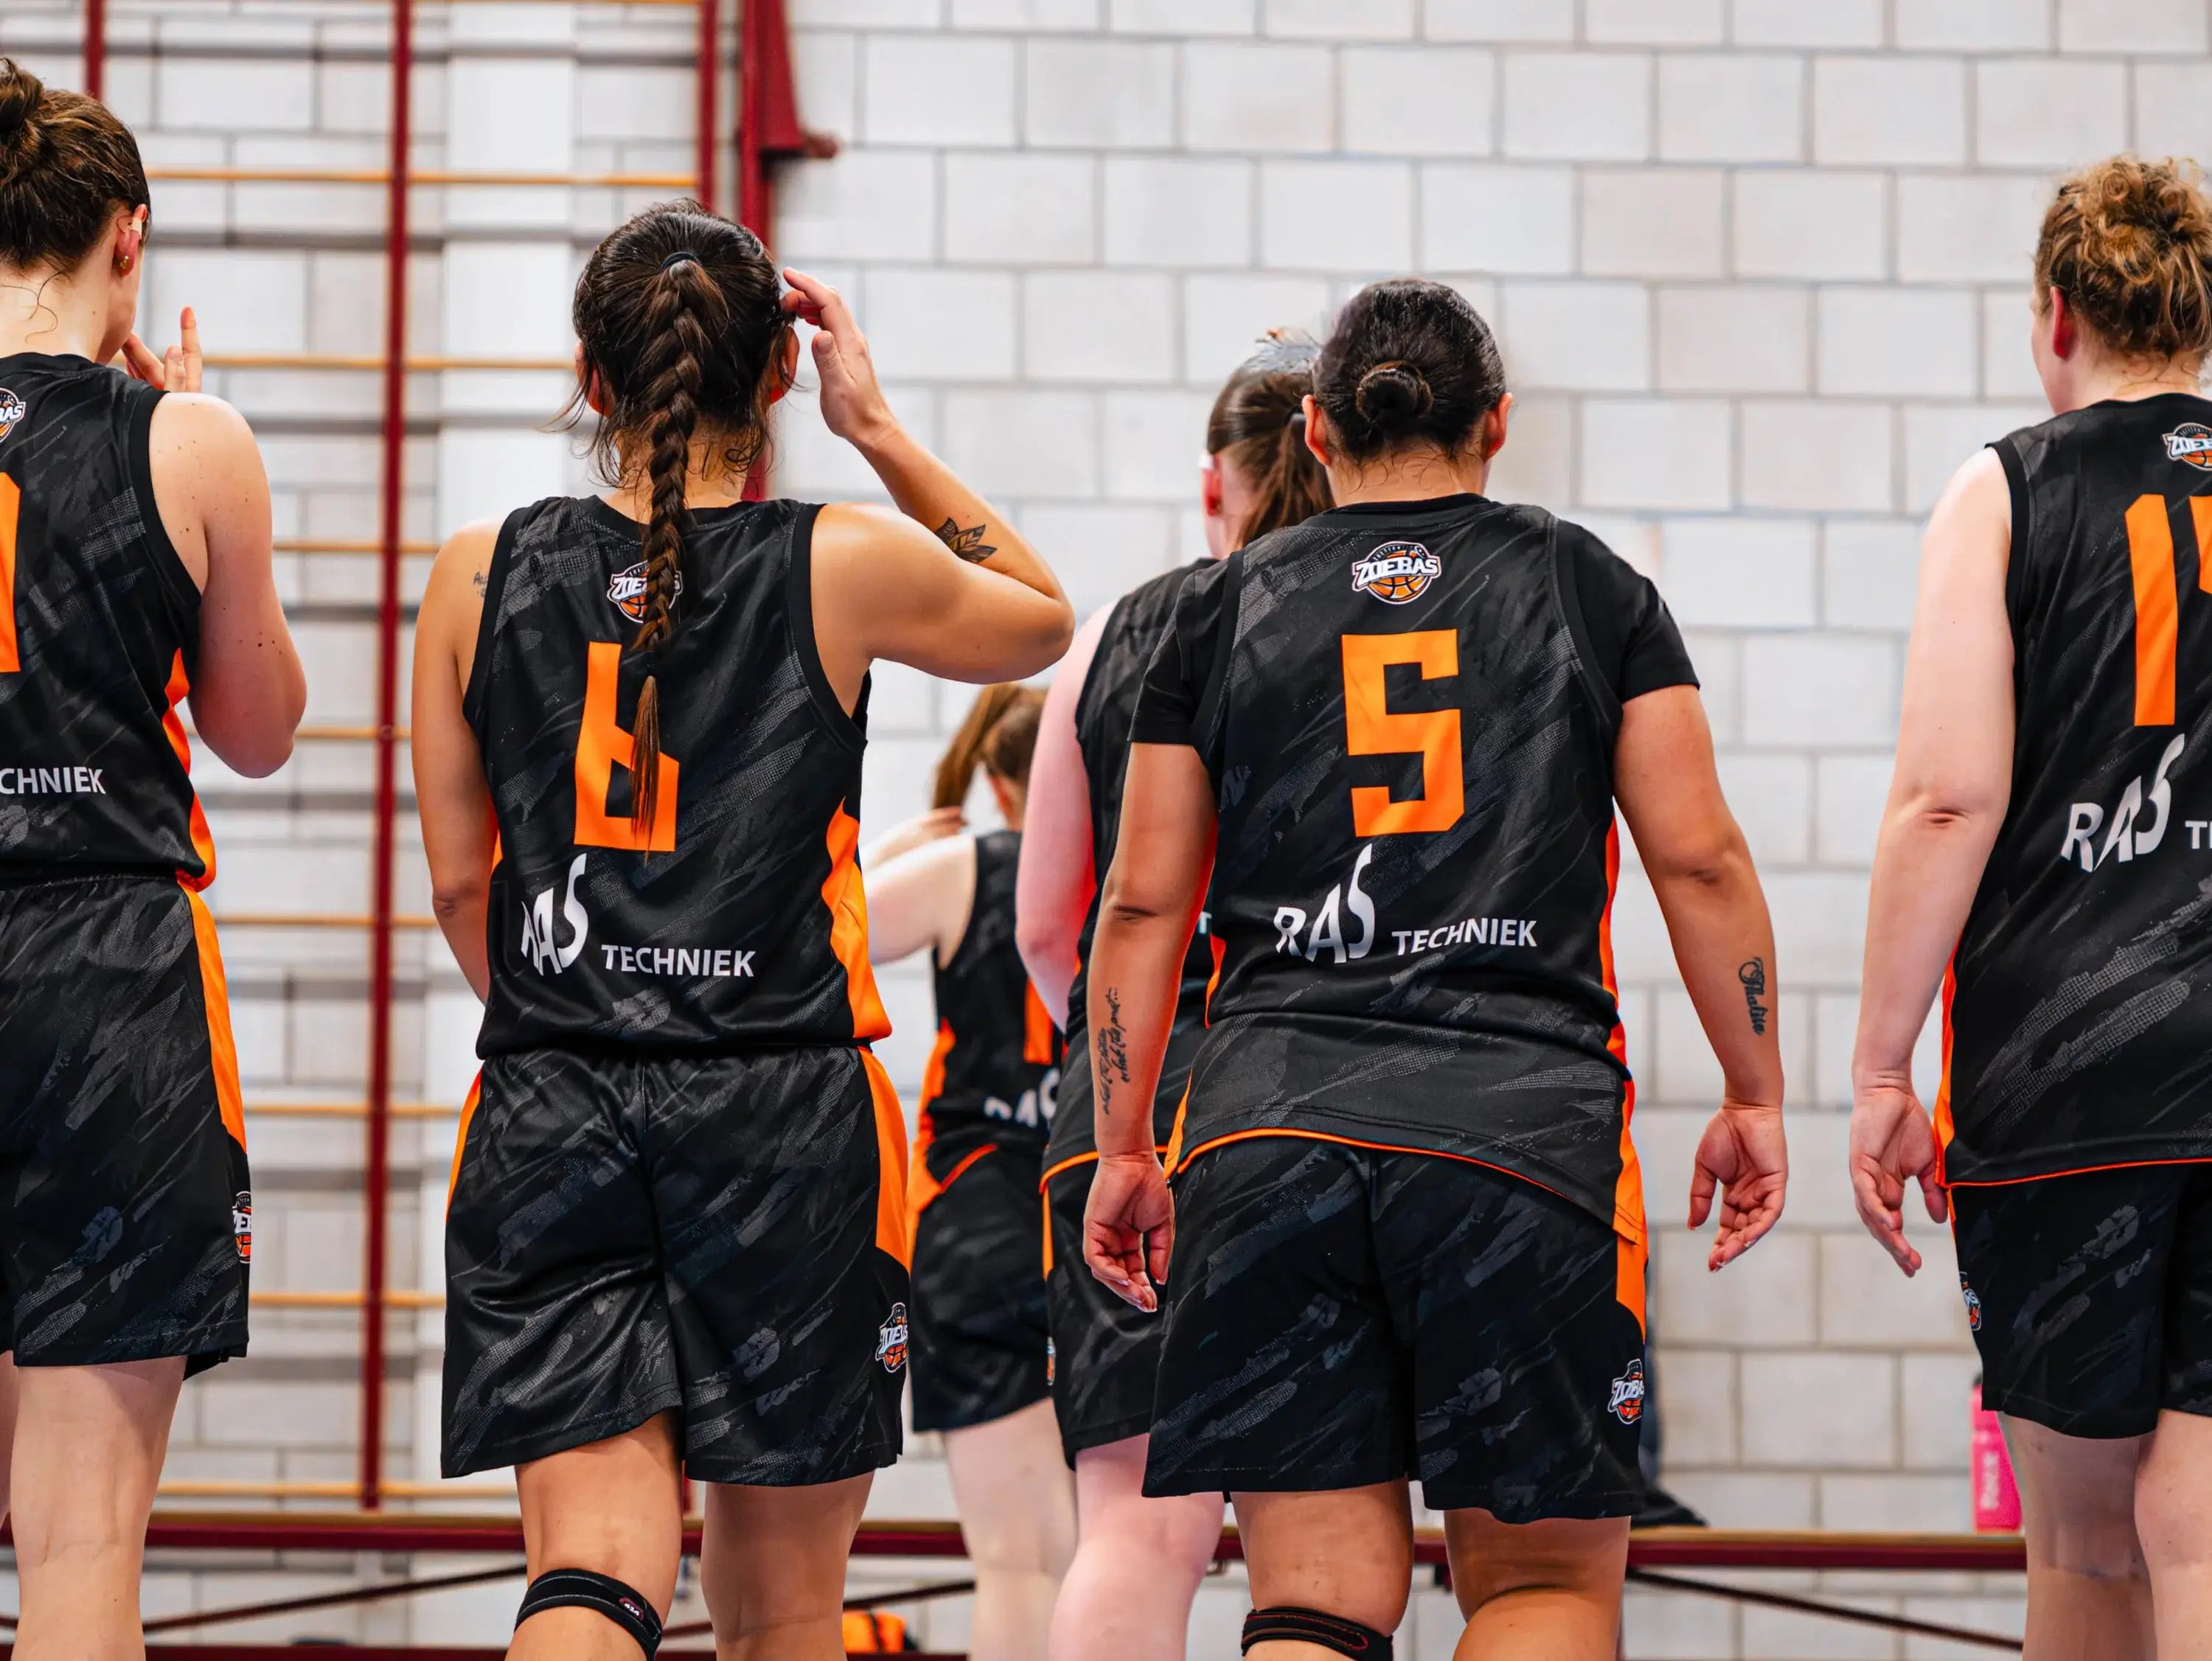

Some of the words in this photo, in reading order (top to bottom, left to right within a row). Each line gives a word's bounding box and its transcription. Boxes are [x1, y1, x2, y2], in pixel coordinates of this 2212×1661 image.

[1355, 557, 1439, 587] ZOEBAS
[574, 642, 679, 852] 6
[1342, 630, 1464, 837] 5
[2061, 734, 2185, 872] RAS
[601, 944, 756, 977] TECHNIEK
[1273, 843, 1375, 964] RAS
[1391, 918, 1537, 956] TECHNIEK
